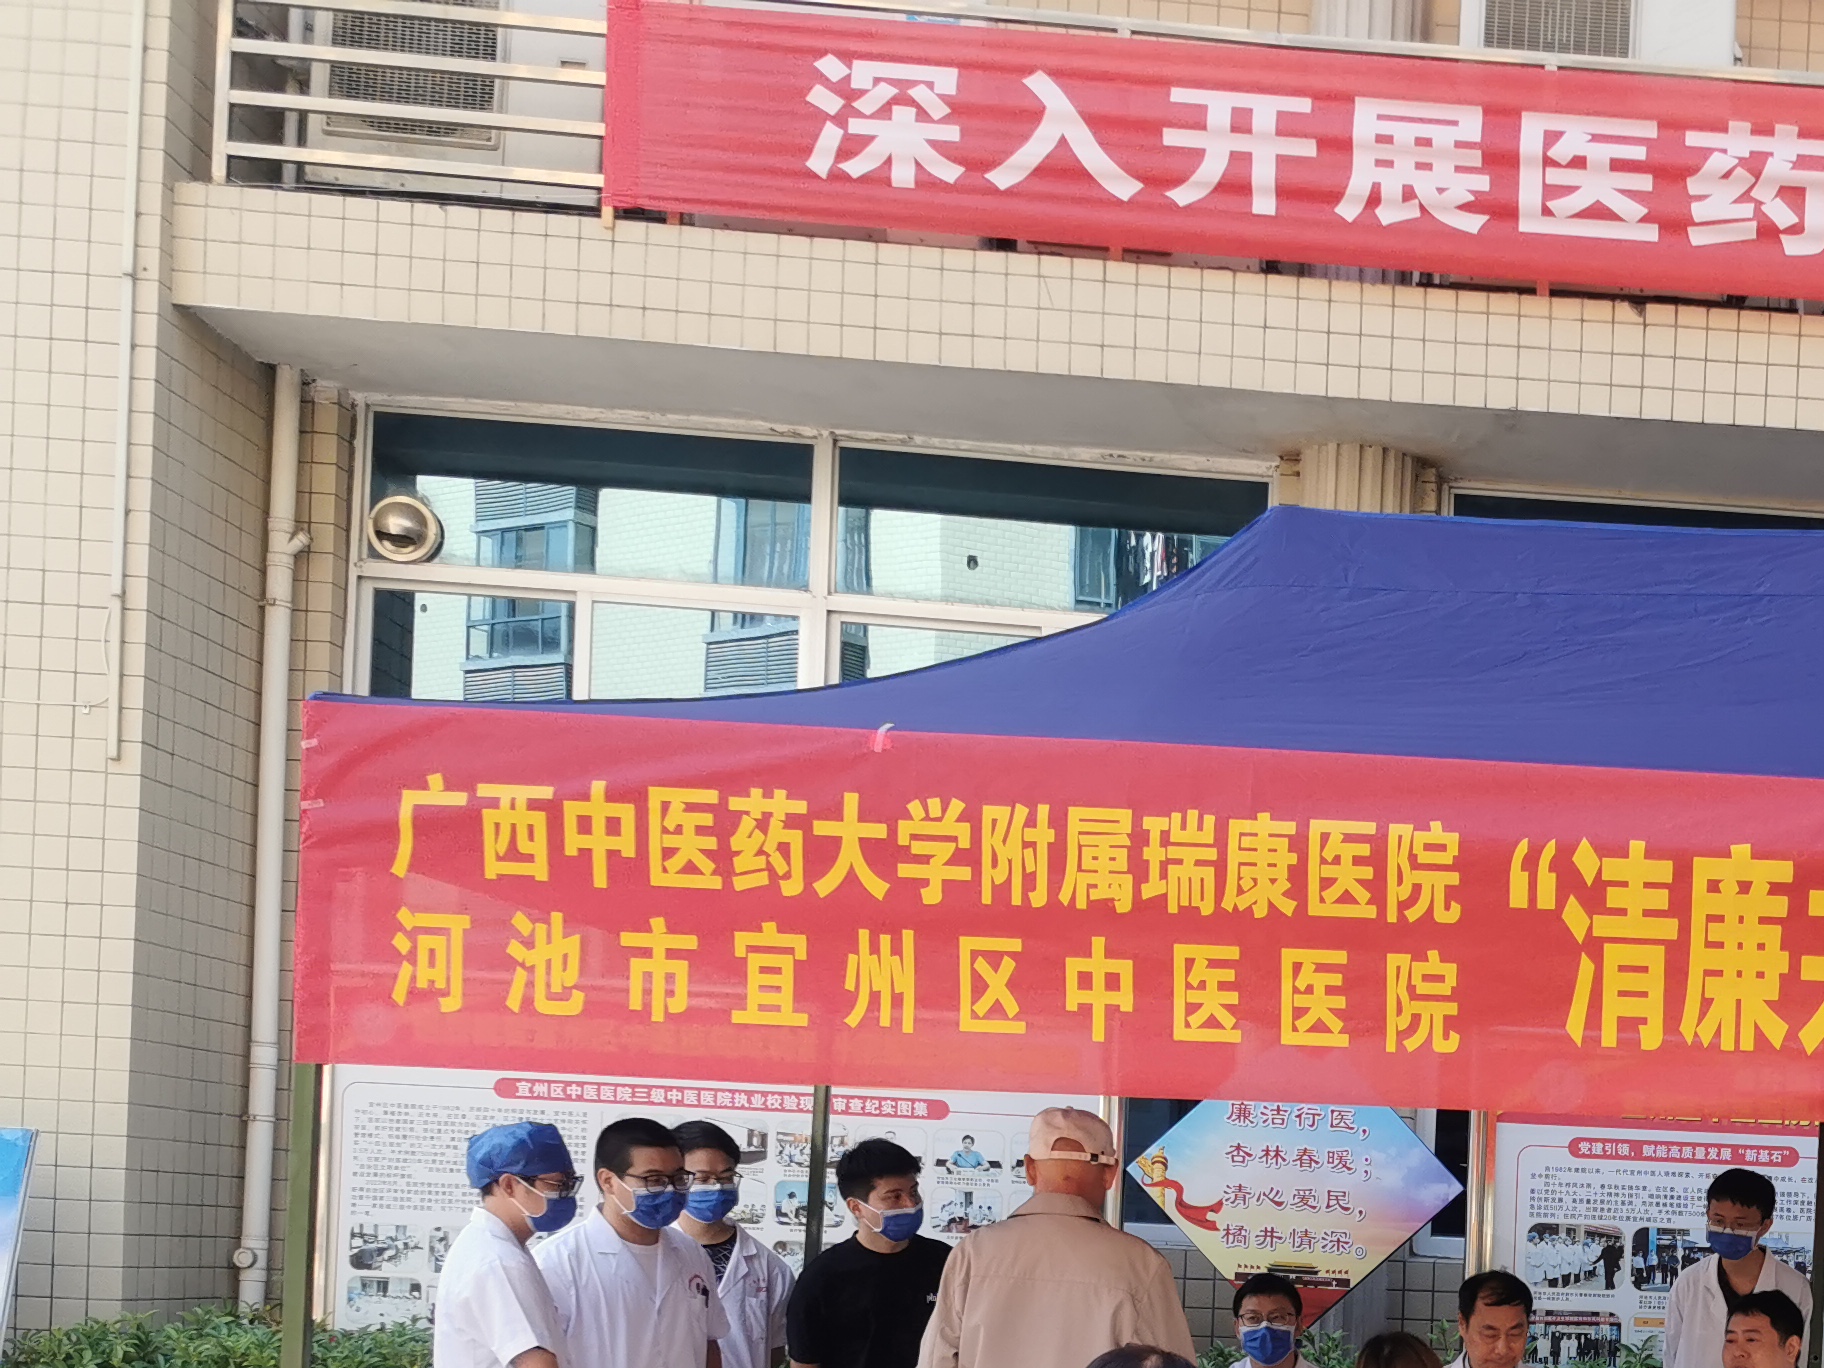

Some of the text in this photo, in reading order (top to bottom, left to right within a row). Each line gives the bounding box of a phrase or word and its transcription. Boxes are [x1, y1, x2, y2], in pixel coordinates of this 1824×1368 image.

[391, 773, 1461, 924] 广西中医药大学附属瑞康医院
[389, 908, 1461, 1053] 河池市宜州区中医医院
[515, 1081, 929, 1118] 宜州区中医医院三级中医医院执业校验现审查纪实图集
